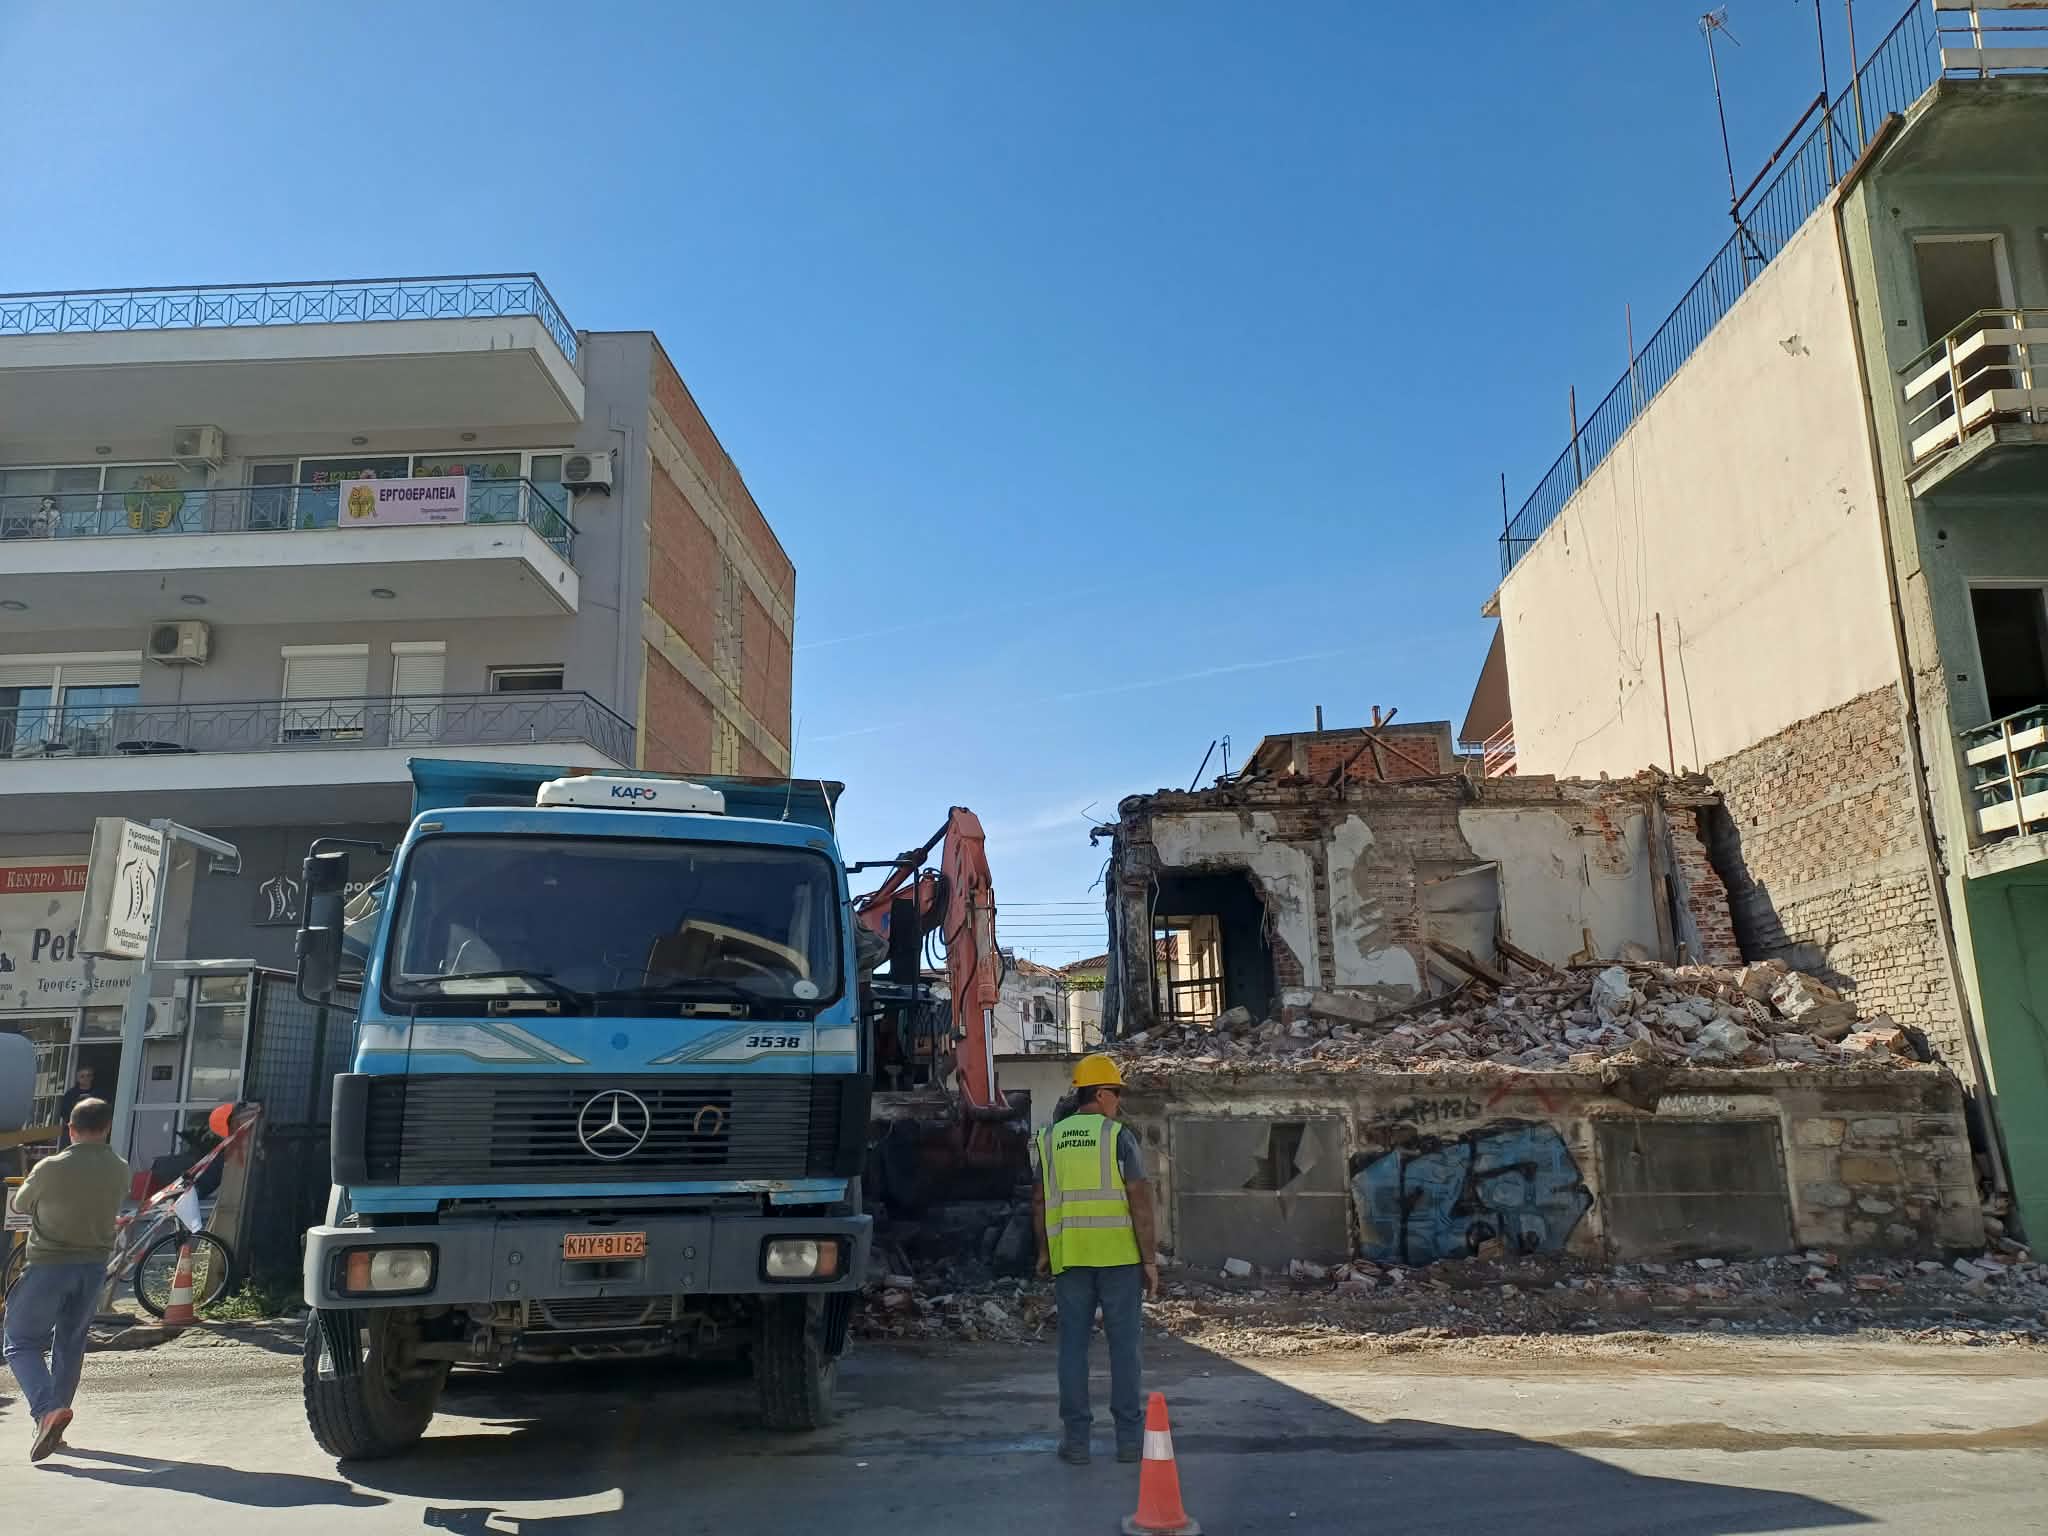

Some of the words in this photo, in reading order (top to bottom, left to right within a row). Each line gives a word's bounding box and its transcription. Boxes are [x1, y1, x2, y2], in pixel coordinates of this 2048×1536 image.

[379, 486, 456, 503] ΕΡΓΟΘΕΡΑΠΕΙΑ
[7, 871, 55, 888] ΚΕΝΤΡΟ
[746, 1036, 800, 1048] 3538
[1062, 1129, 1090, 1139] ΔΗΜΟΣ
[1056, 1139, 1096, 1151] ΛΑΡΙΣΑΙΩΝ
